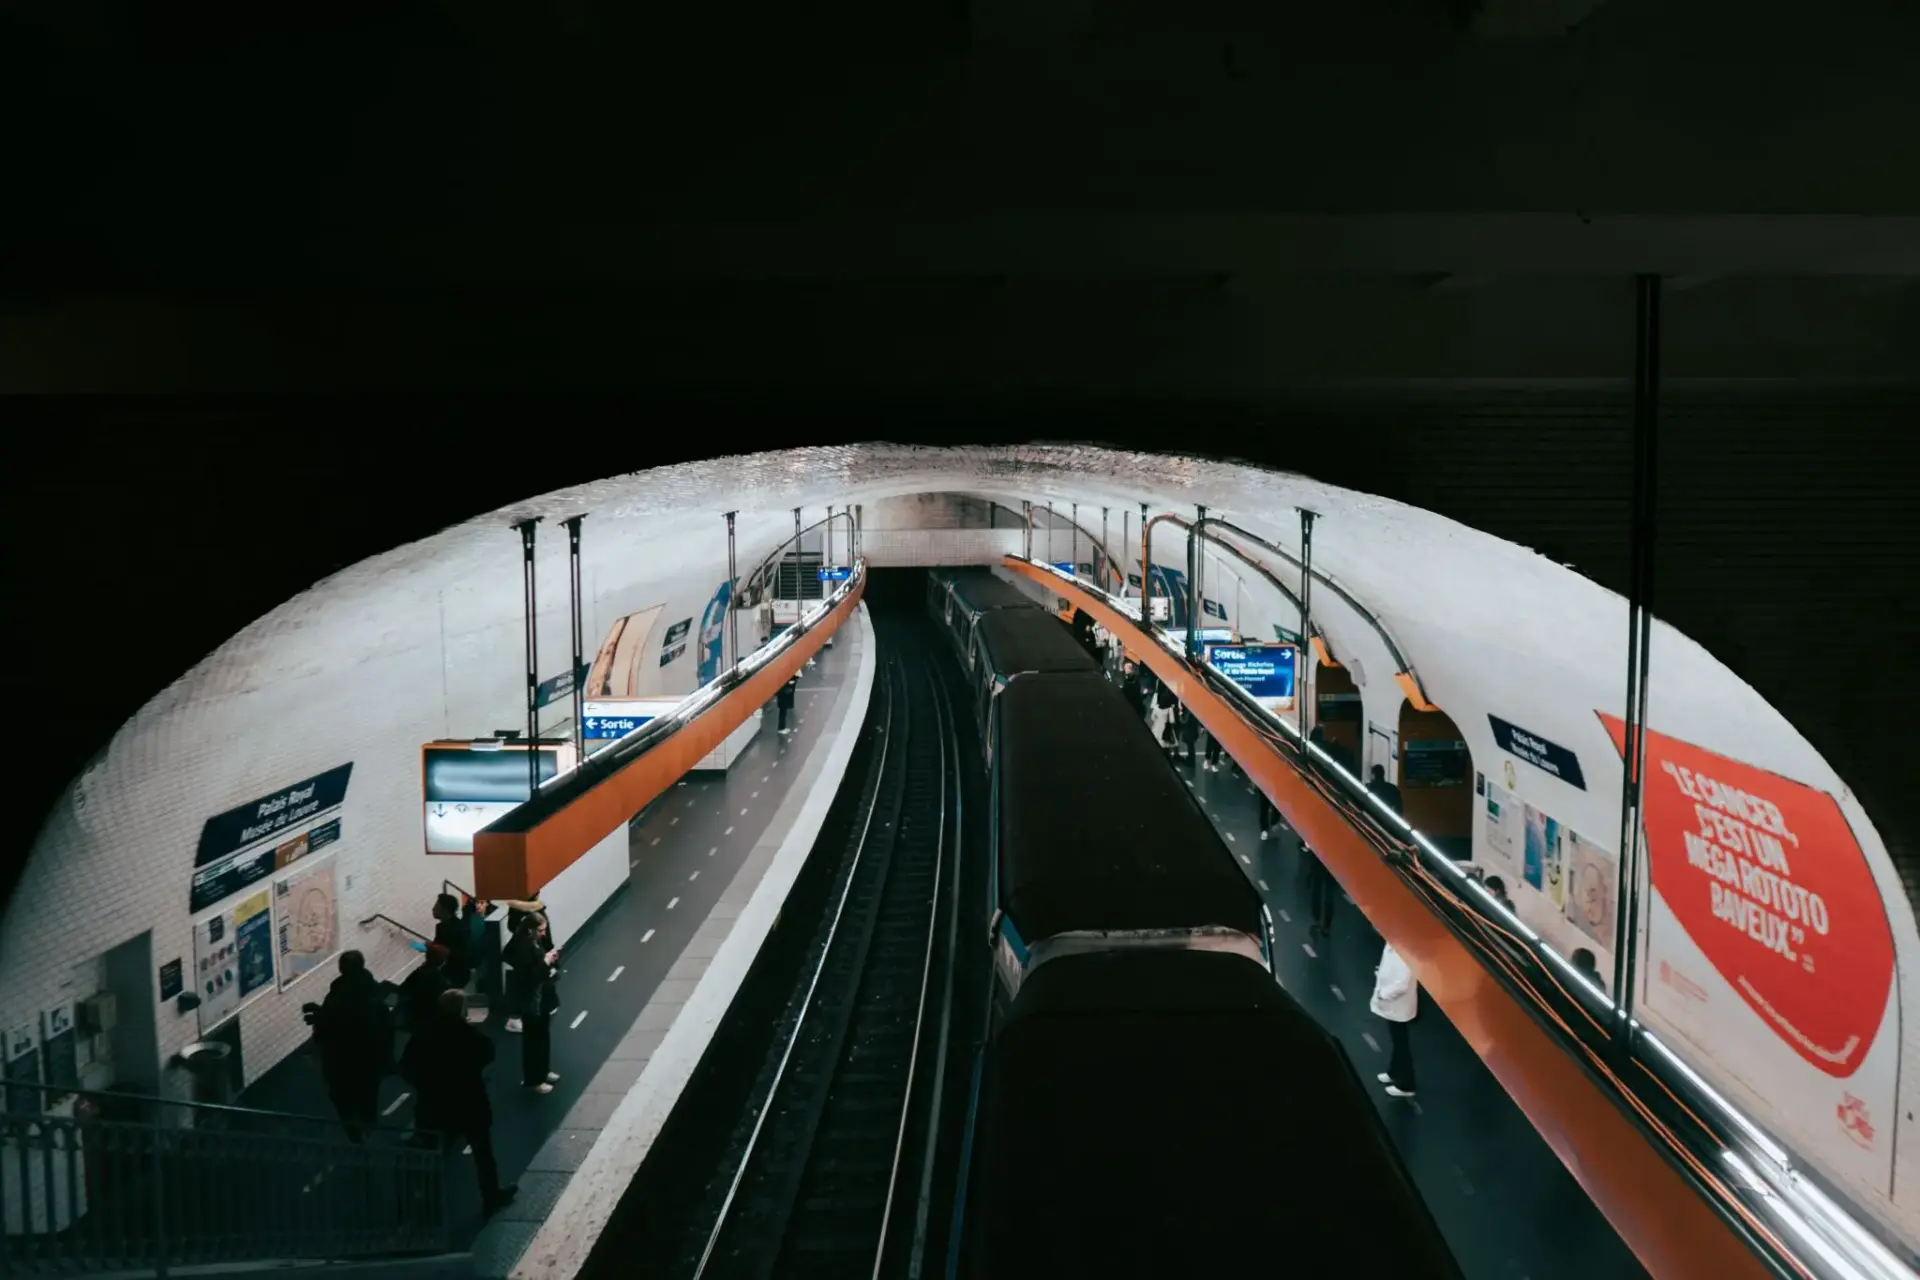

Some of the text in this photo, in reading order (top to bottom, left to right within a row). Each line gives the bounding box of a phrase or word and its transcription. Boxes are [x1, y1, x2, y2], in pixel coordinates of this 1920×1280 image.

[1214, 649, 1246, 660] Sortie
[600, 718, 634, 730] Sortie
[257, 782, 315, 819] Palais Royal
[1738, 858, 1830, 935] ROTOTO
